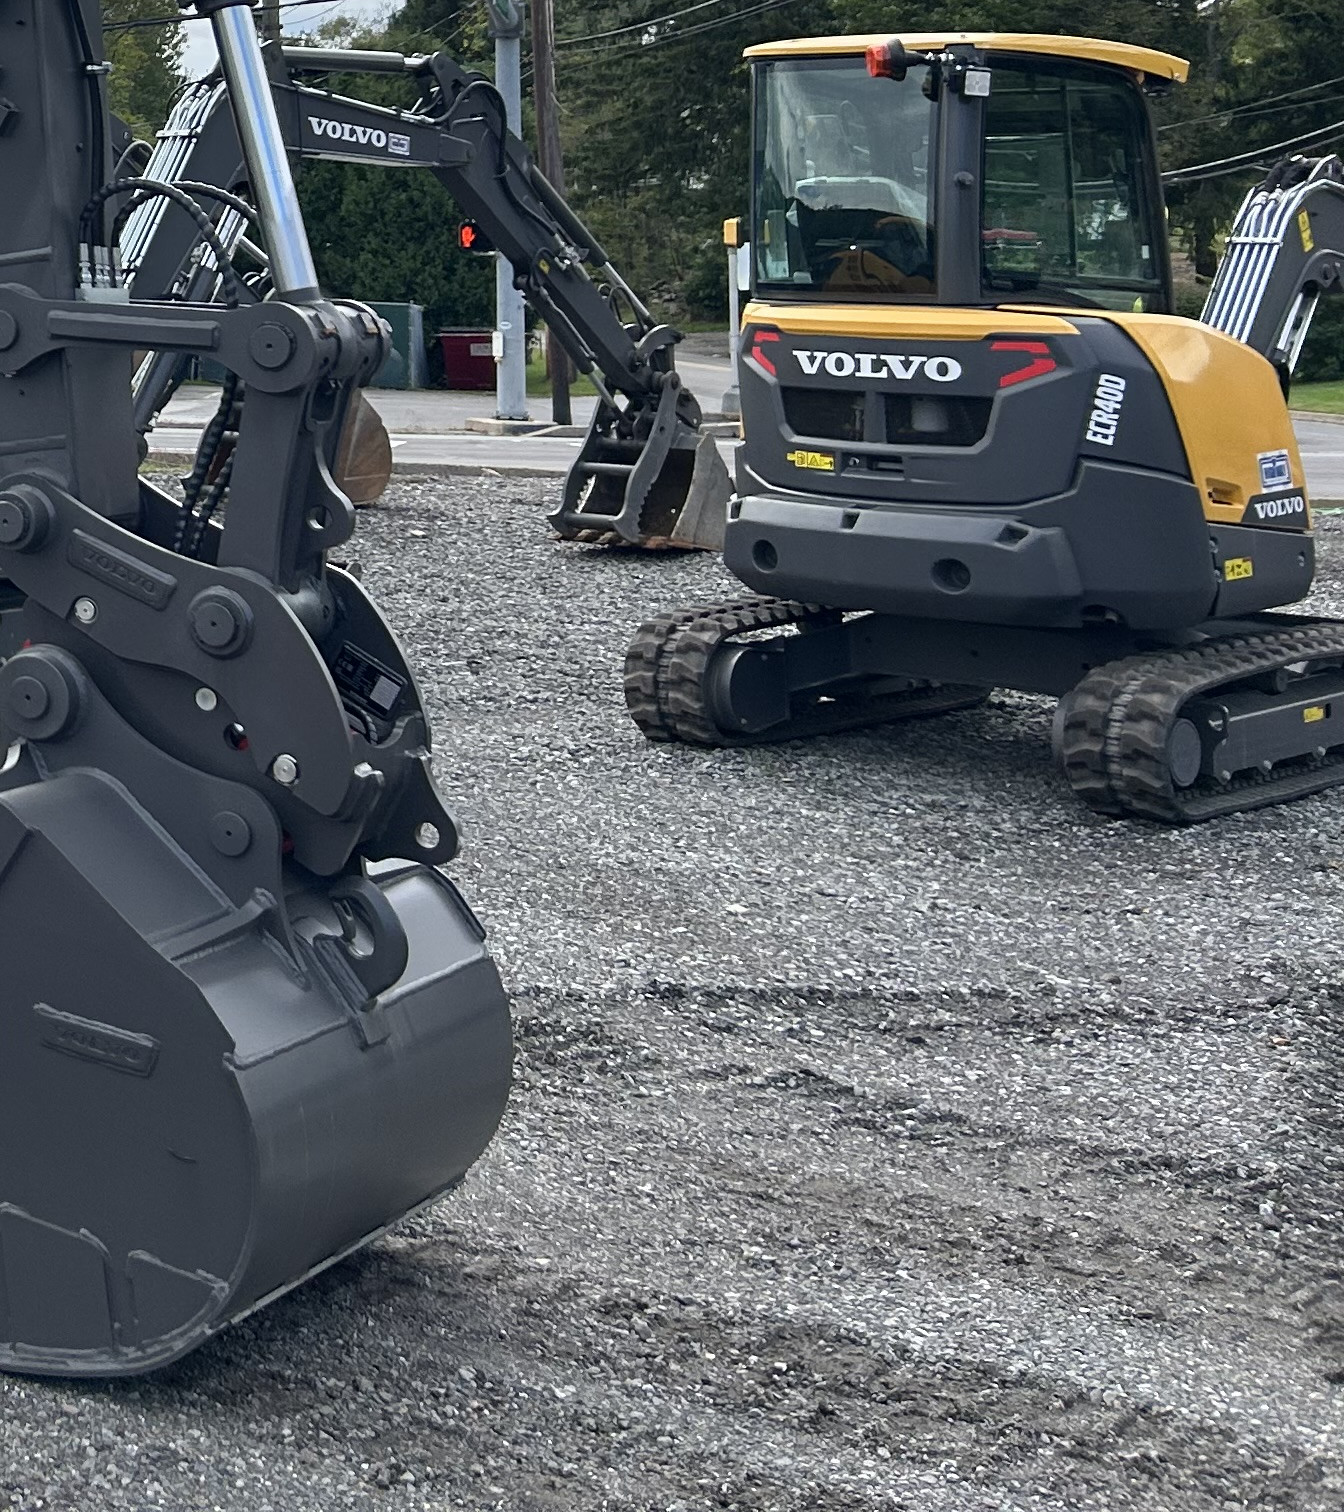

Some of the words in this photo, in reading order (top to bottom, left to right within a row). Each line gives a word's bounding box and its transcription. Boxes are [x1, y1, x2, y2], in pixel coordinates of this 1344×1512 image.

[308, 116, 387, 148] VOLVO
[792, 349, 963, 382] VOLVO
[1085, 373, 1127, 446] ECR40D
[1254, 496, 1304, 520] VOLVO
